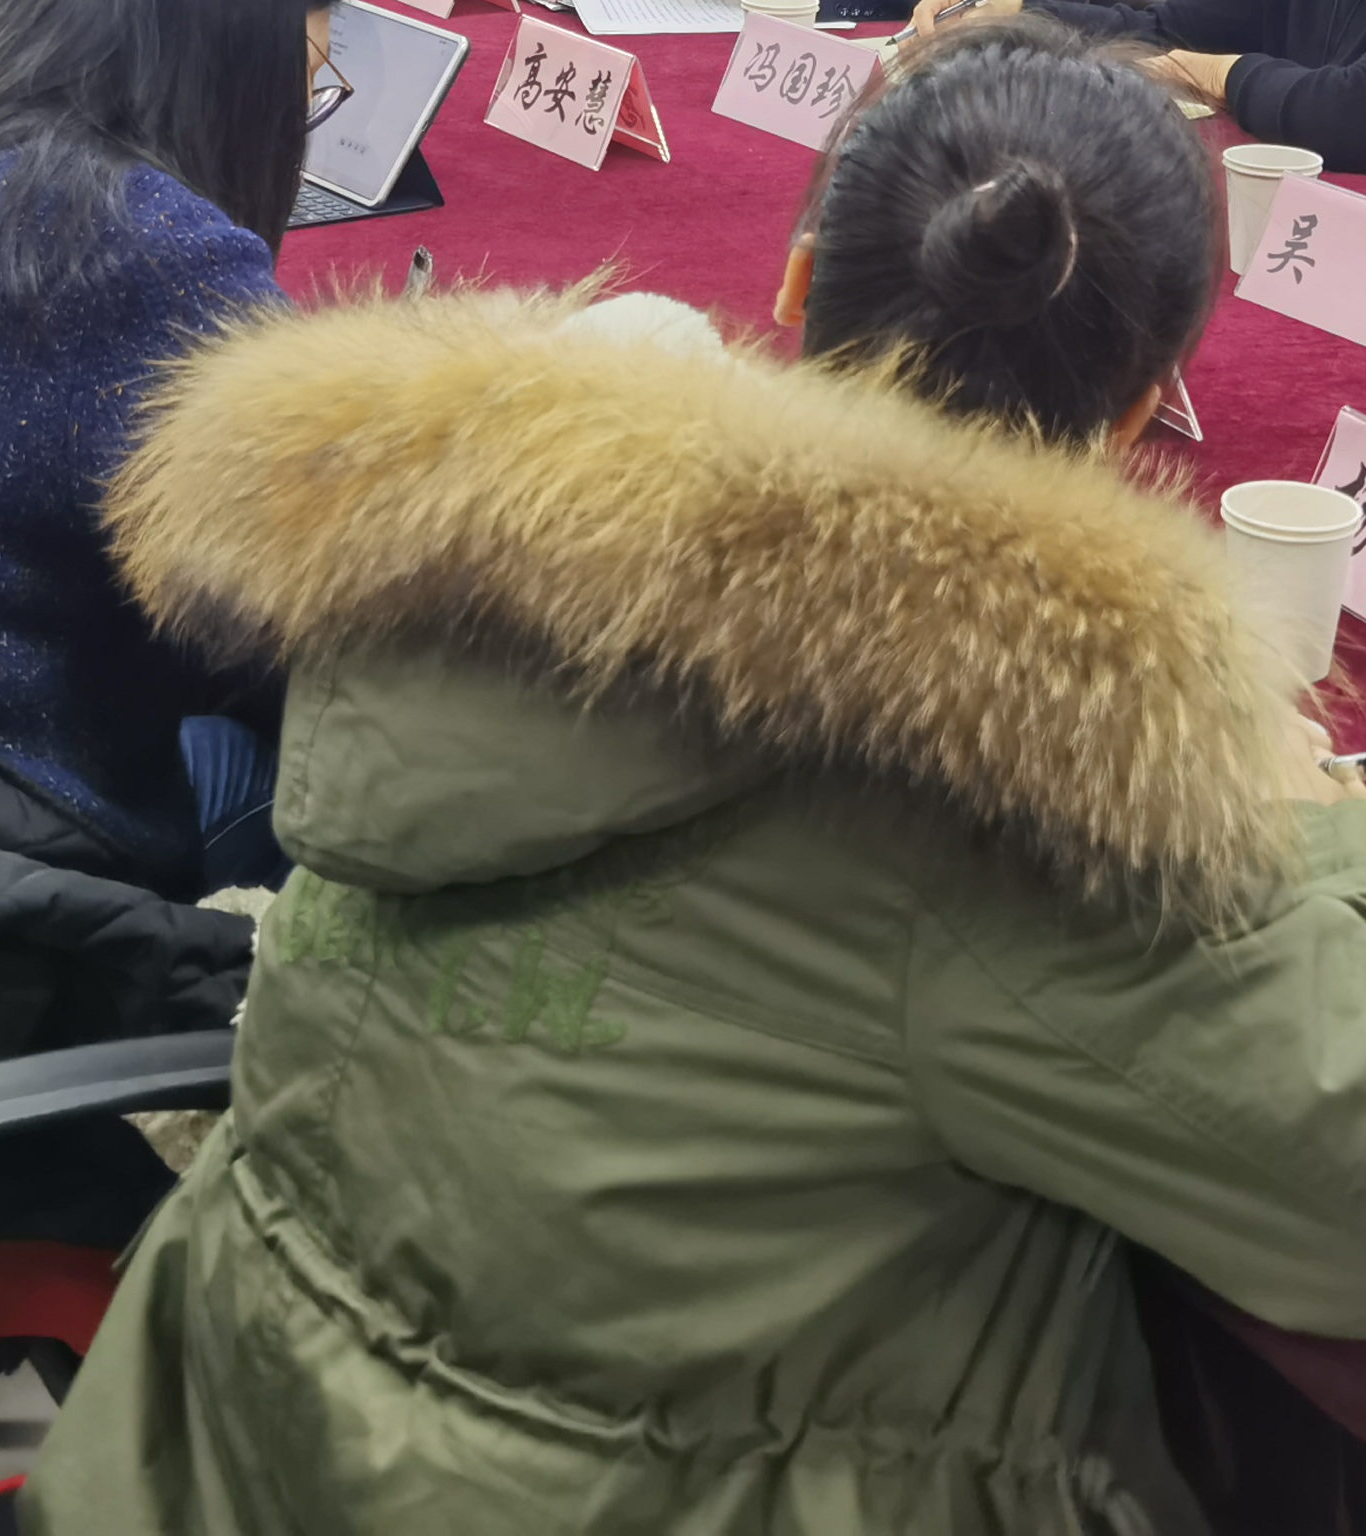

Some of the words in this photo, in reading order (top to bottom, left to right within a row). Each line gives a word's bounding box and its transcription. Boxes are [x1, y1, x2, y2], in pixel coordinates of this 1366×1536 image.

[513, 42, 613, 136] 高安慧
[743, 42, 858, 120] 冯国珍
